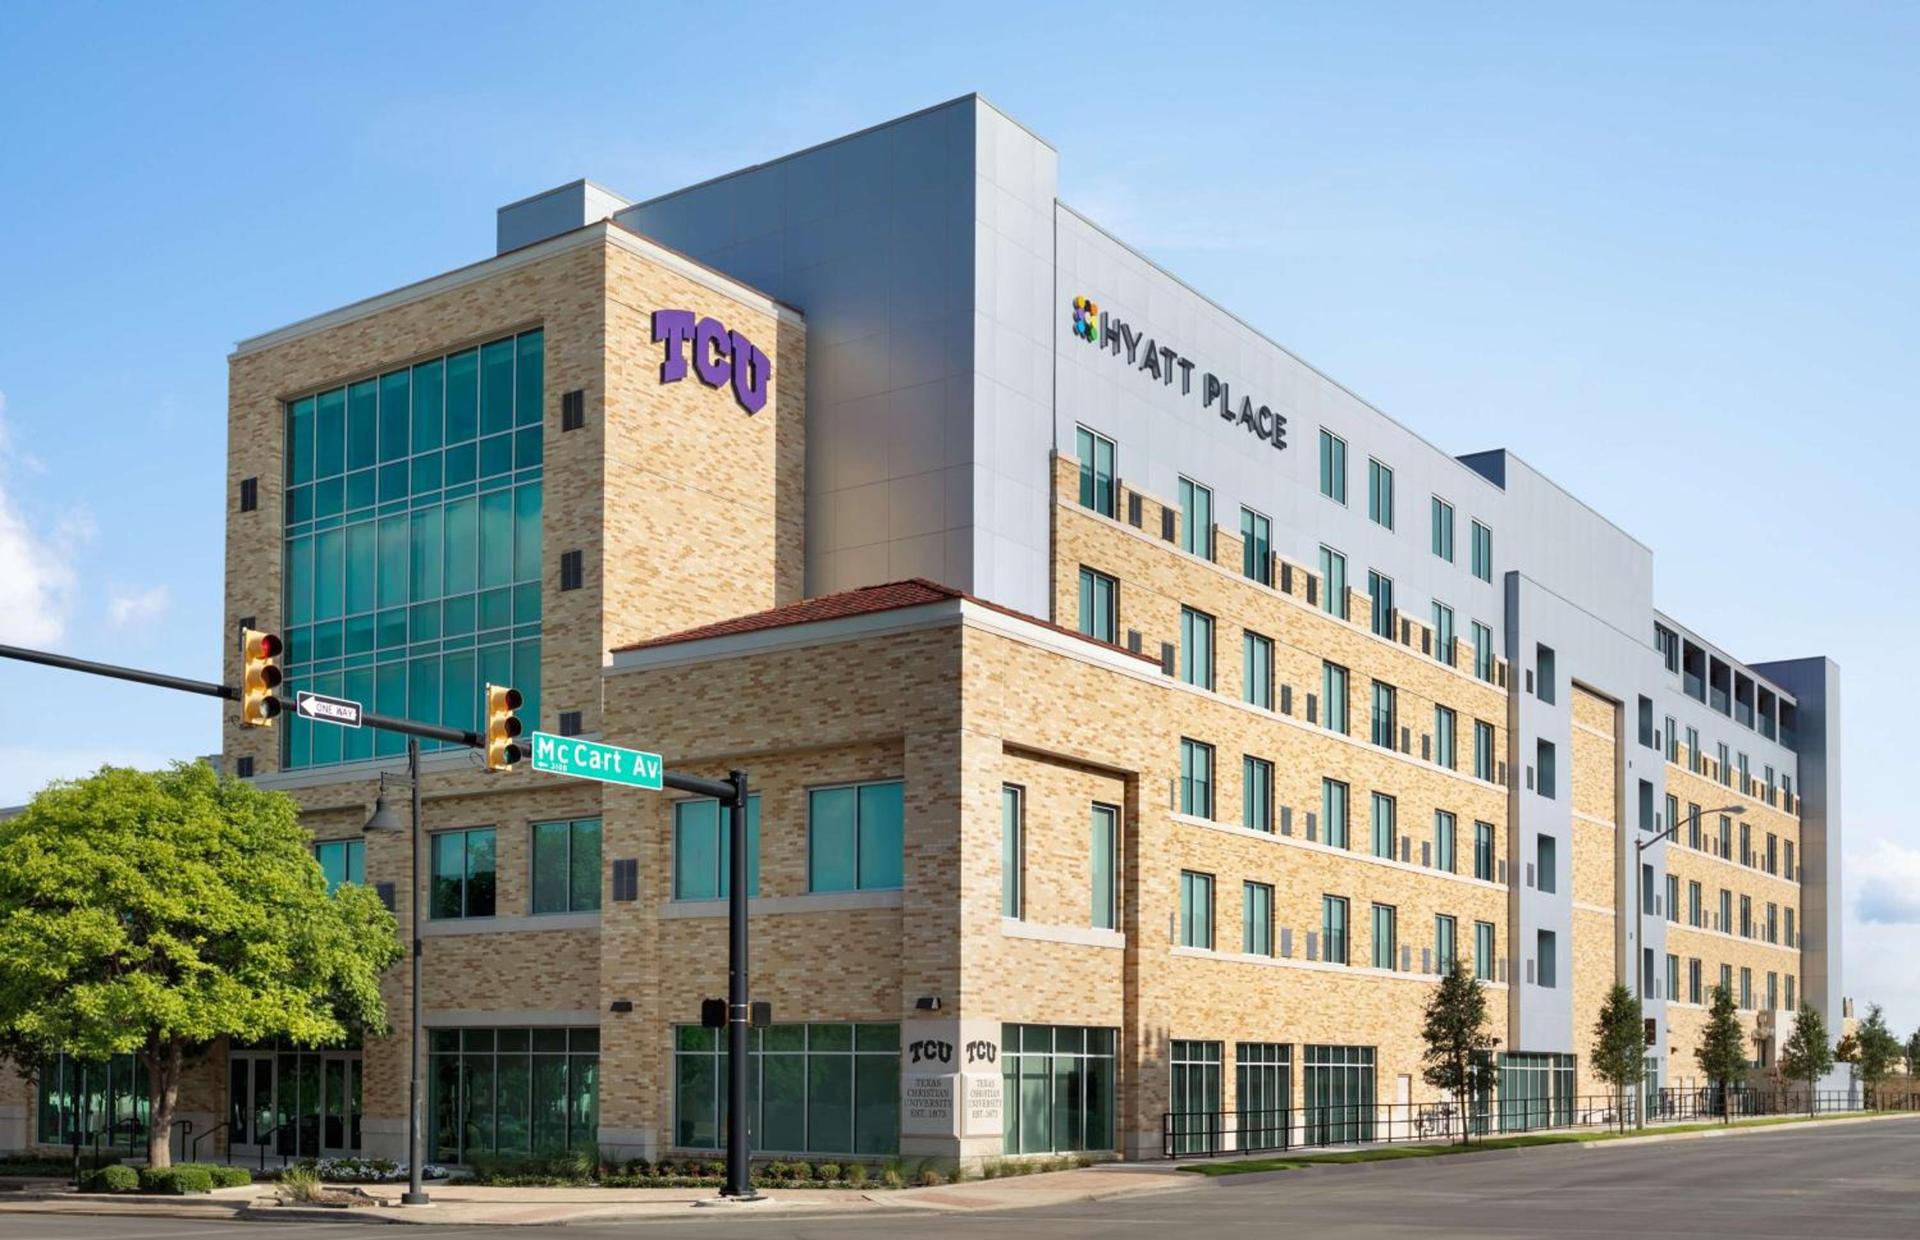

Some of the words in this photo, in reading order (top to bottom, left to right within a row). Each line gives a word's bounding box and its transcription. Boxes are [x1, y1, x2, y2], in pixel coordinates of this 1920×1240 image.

[651, 309, 771, 417] TCU
[1100, 311, 1196, 397] HYATT
[1203, 373, 1288, 451] PLACE
[315, 702, 333, 714] ONE
[336, 706, 354, 718] WAY
[632, 755, 658, 779] Av
[909, 1040, 952, 1064] TCU
[966, 1040, 997, 1064] TCU
[916, 1079, 942, 1087] TEXAS
[976, 1080, 995, 1088] TEXAS
[907, 1088, 949, 1097] CHRISTIAN
[970, 1089, 1000, 1097] CHRISTIAN
[905, 1098, 952, 1108] UNIVERSITY
[968, 1099, 1001, 1108] UNIVERSITY
